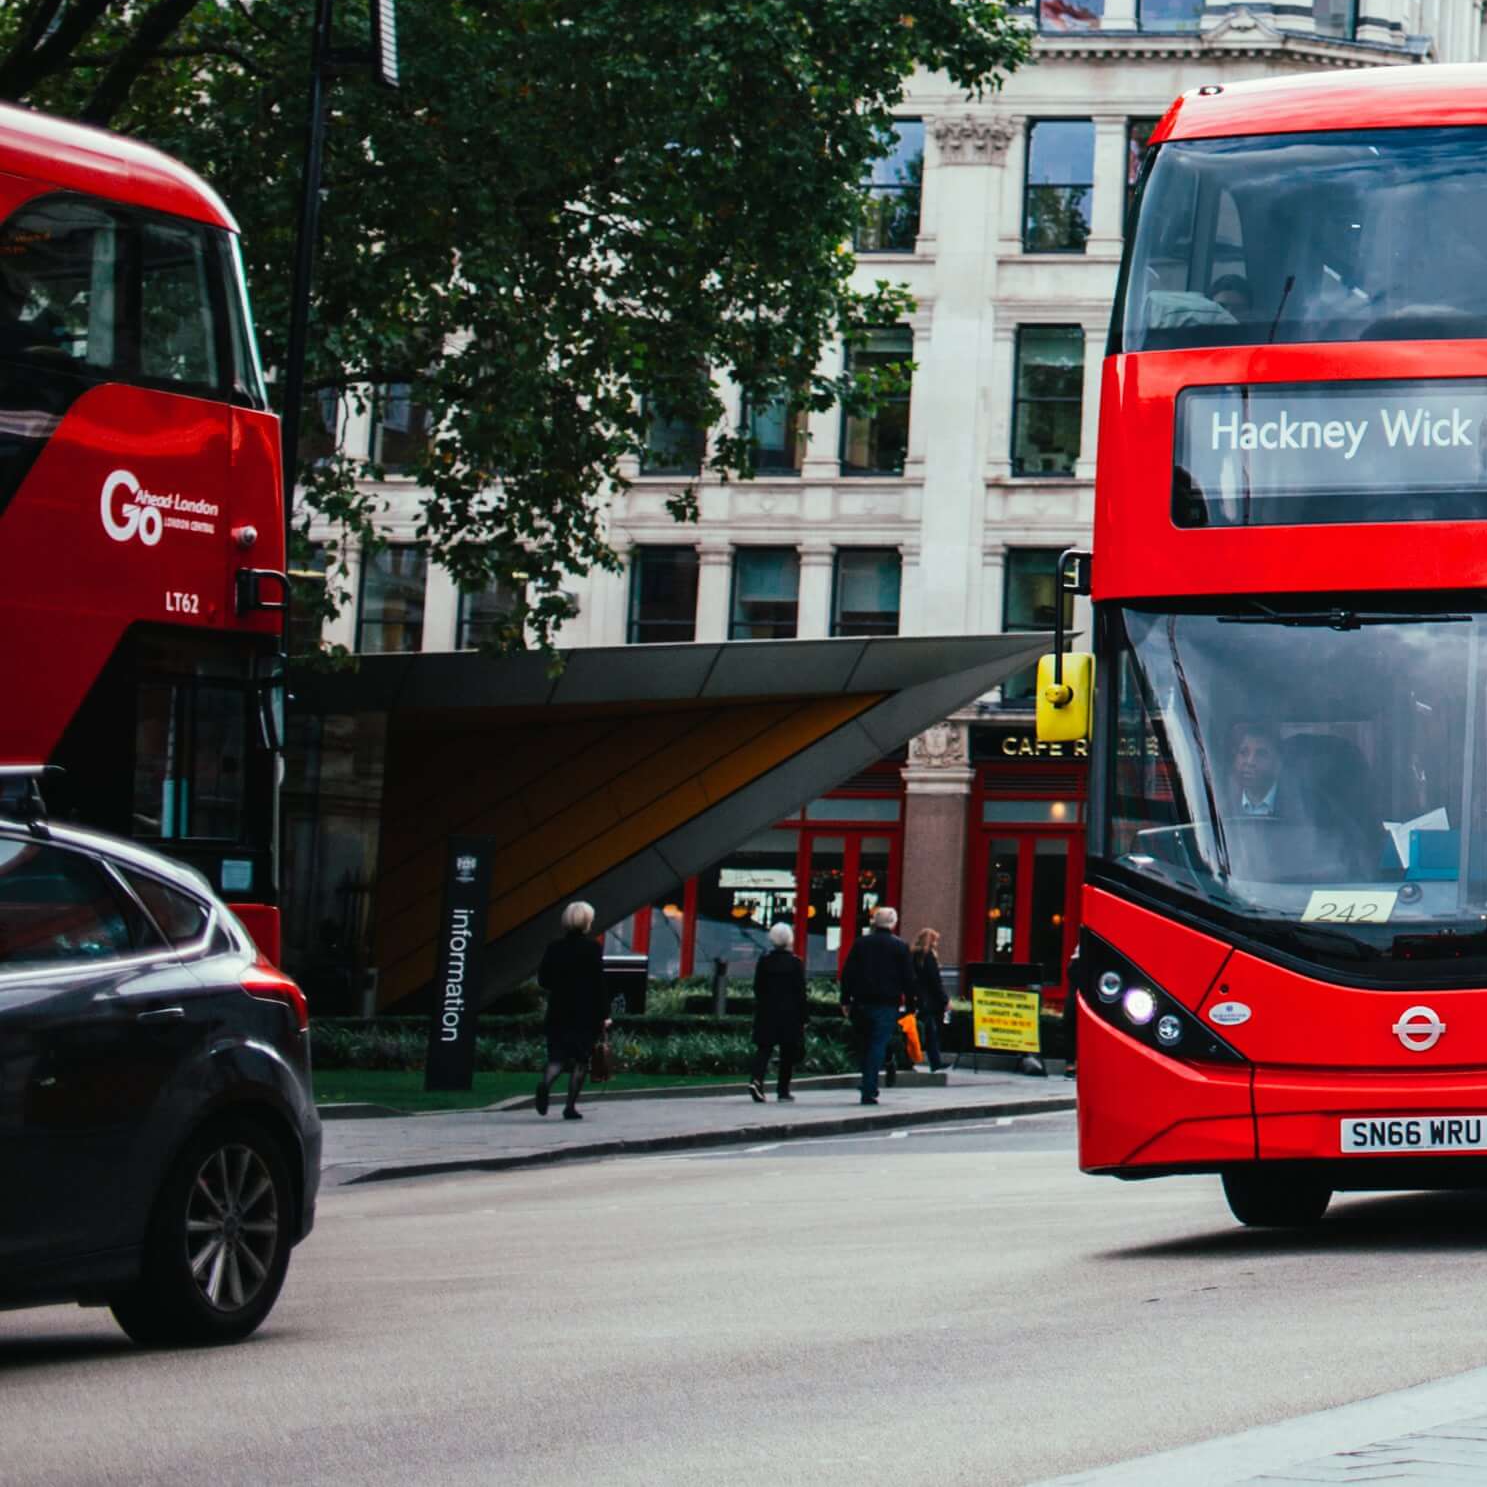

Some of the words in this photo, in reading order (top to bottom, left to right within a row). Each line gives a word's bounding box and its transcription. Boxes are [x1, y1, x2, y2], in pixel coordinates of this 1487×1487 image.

[1210, 409, 1369, 460] Hackney
[1380, 406, 1473, 448] Wick
[101, 470, 163, 546] Go
[165, 591, 200, 614] LT62
[1313, 901, 1379, 923] 242
[440, 908, 475, 1042] information
[1352, 1120, 1421, 1146] SN66
[1430, 1119, 1481, 1145] WRU
